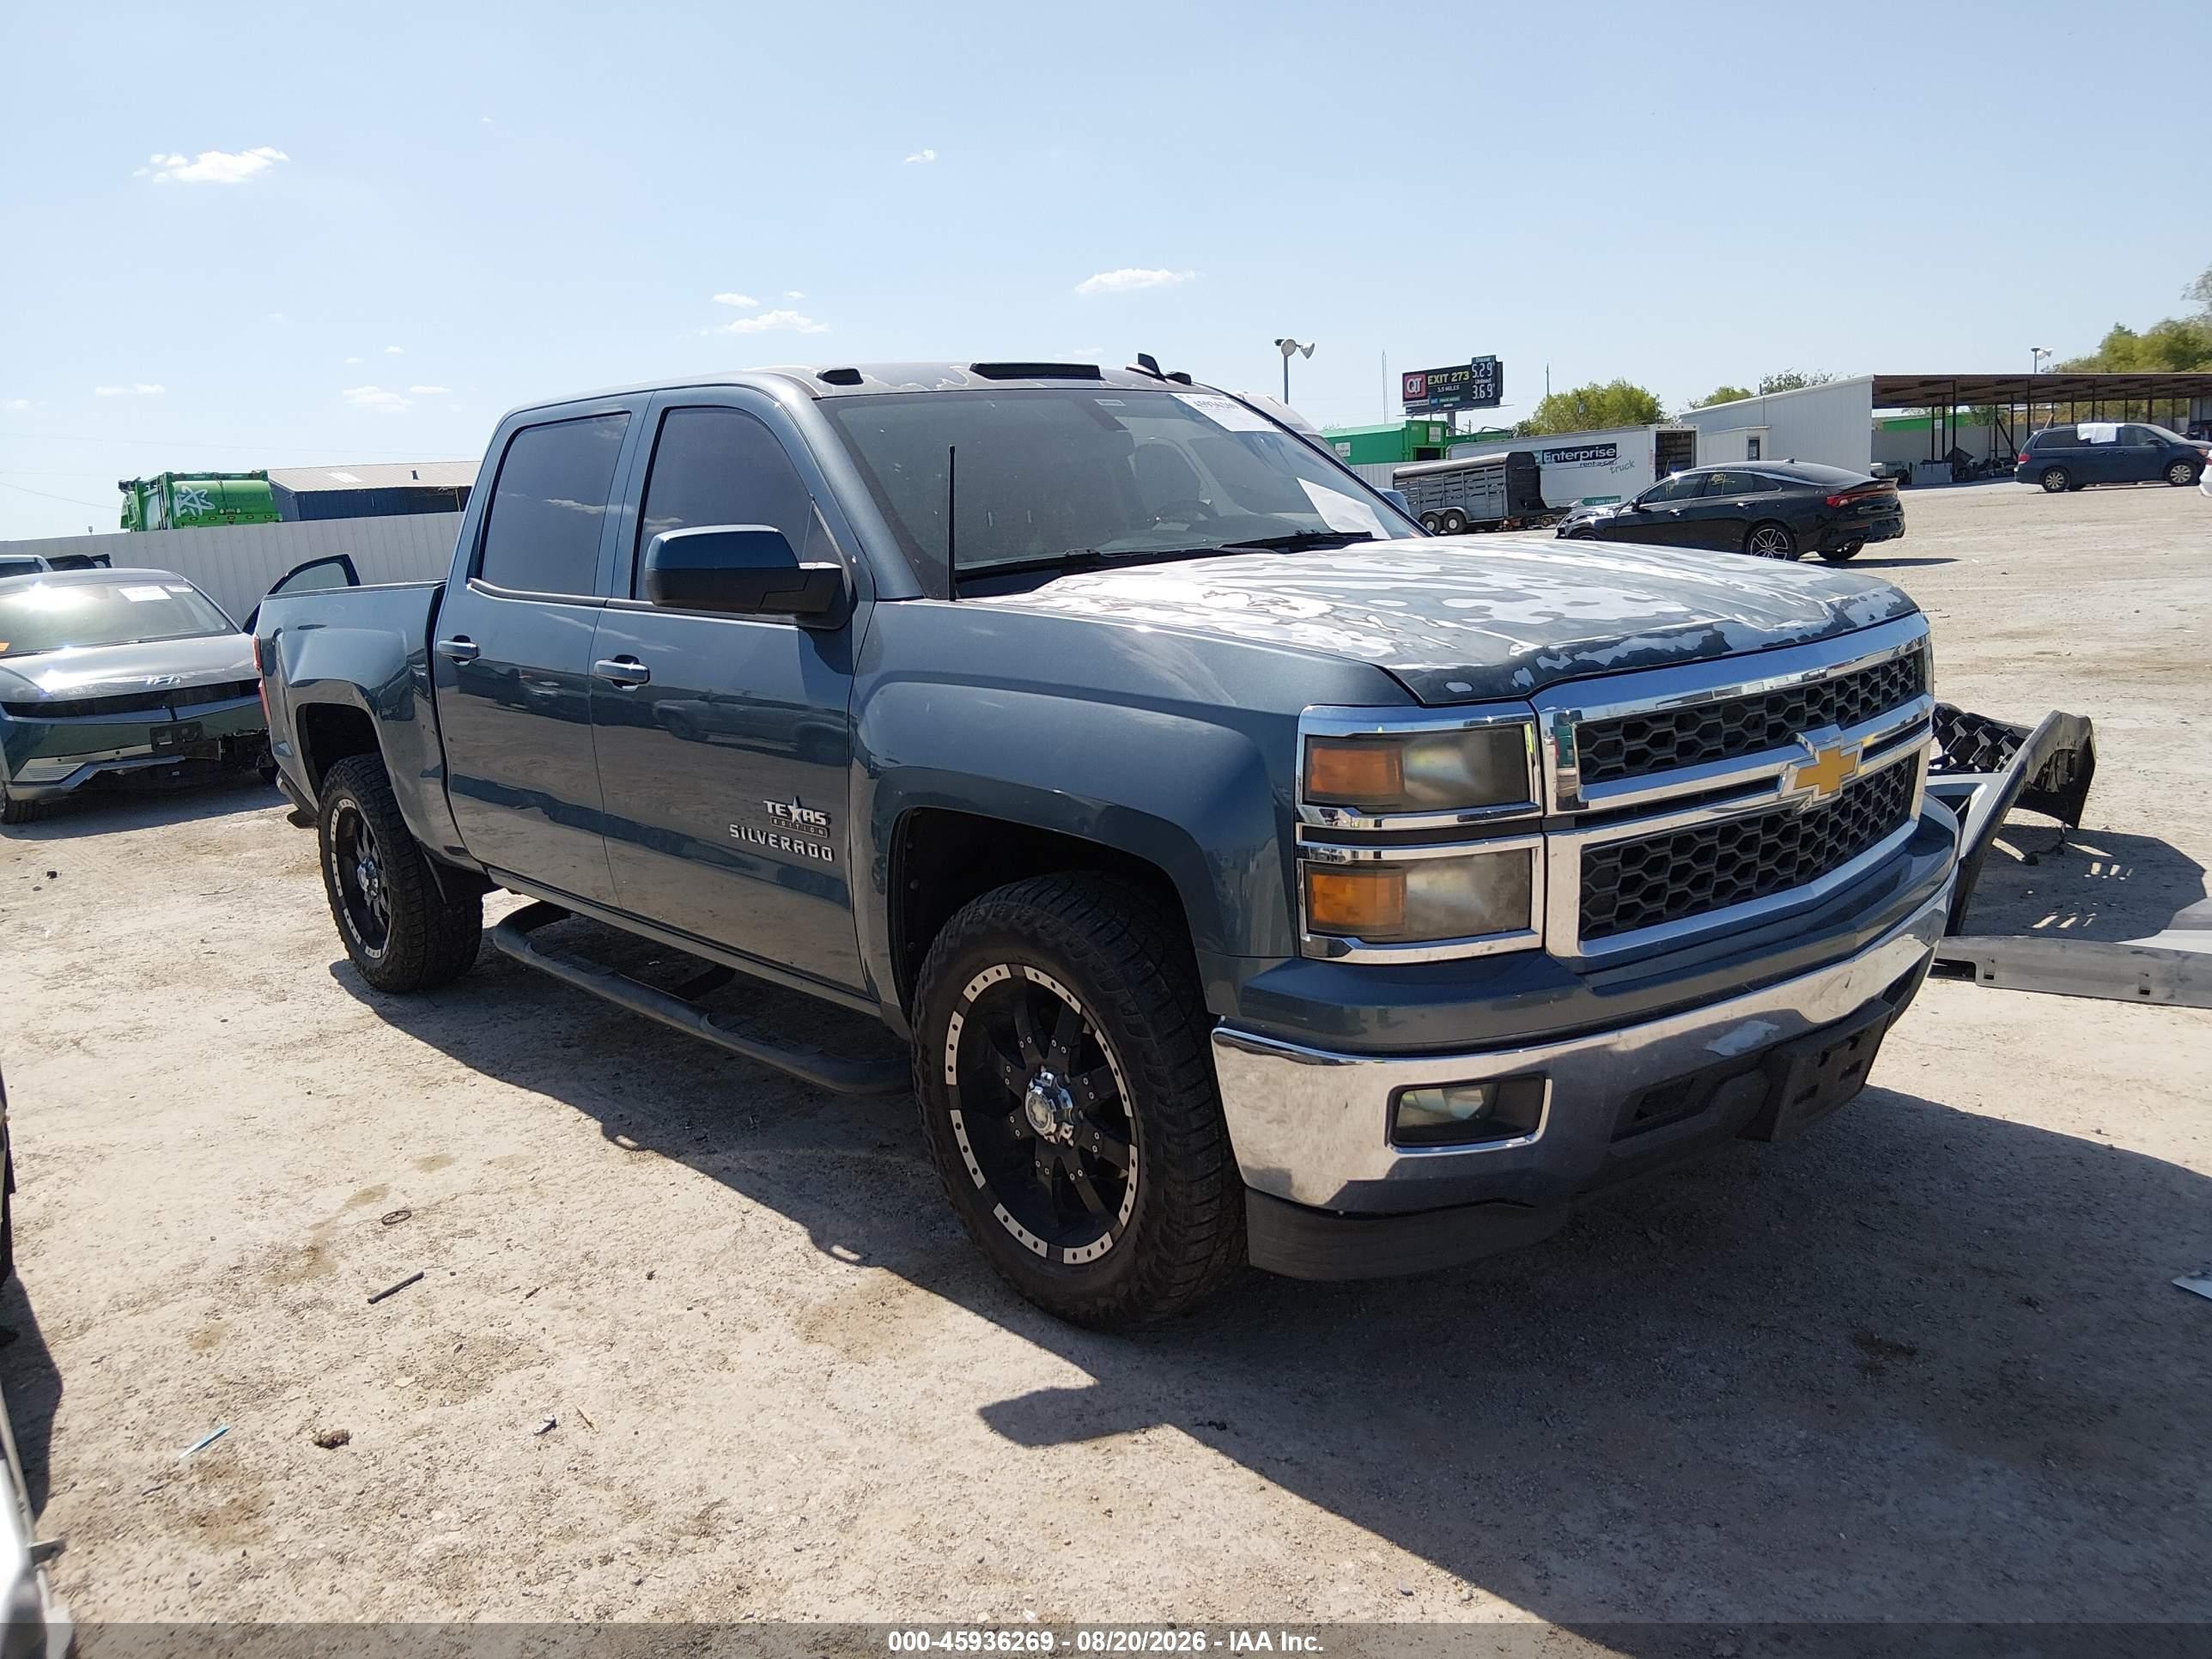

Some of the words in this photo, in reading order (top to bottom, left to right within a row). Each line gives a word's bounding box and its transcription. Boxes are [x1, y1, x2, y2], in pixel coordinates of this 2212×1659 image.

[1407, 377, 1422, 394] QT
[1428, 374, 1449, 385] EXIT
[1451, 371, 1469, 382] 273
[1543, 447, 1616, 463] Enterprise
[1608, 459, 1636, 475] truck
[763, 797, 828, 826] TEXAS
[773, 818, 824, 836] EDITION
[729, 823, 834, 862] SILVERADO
